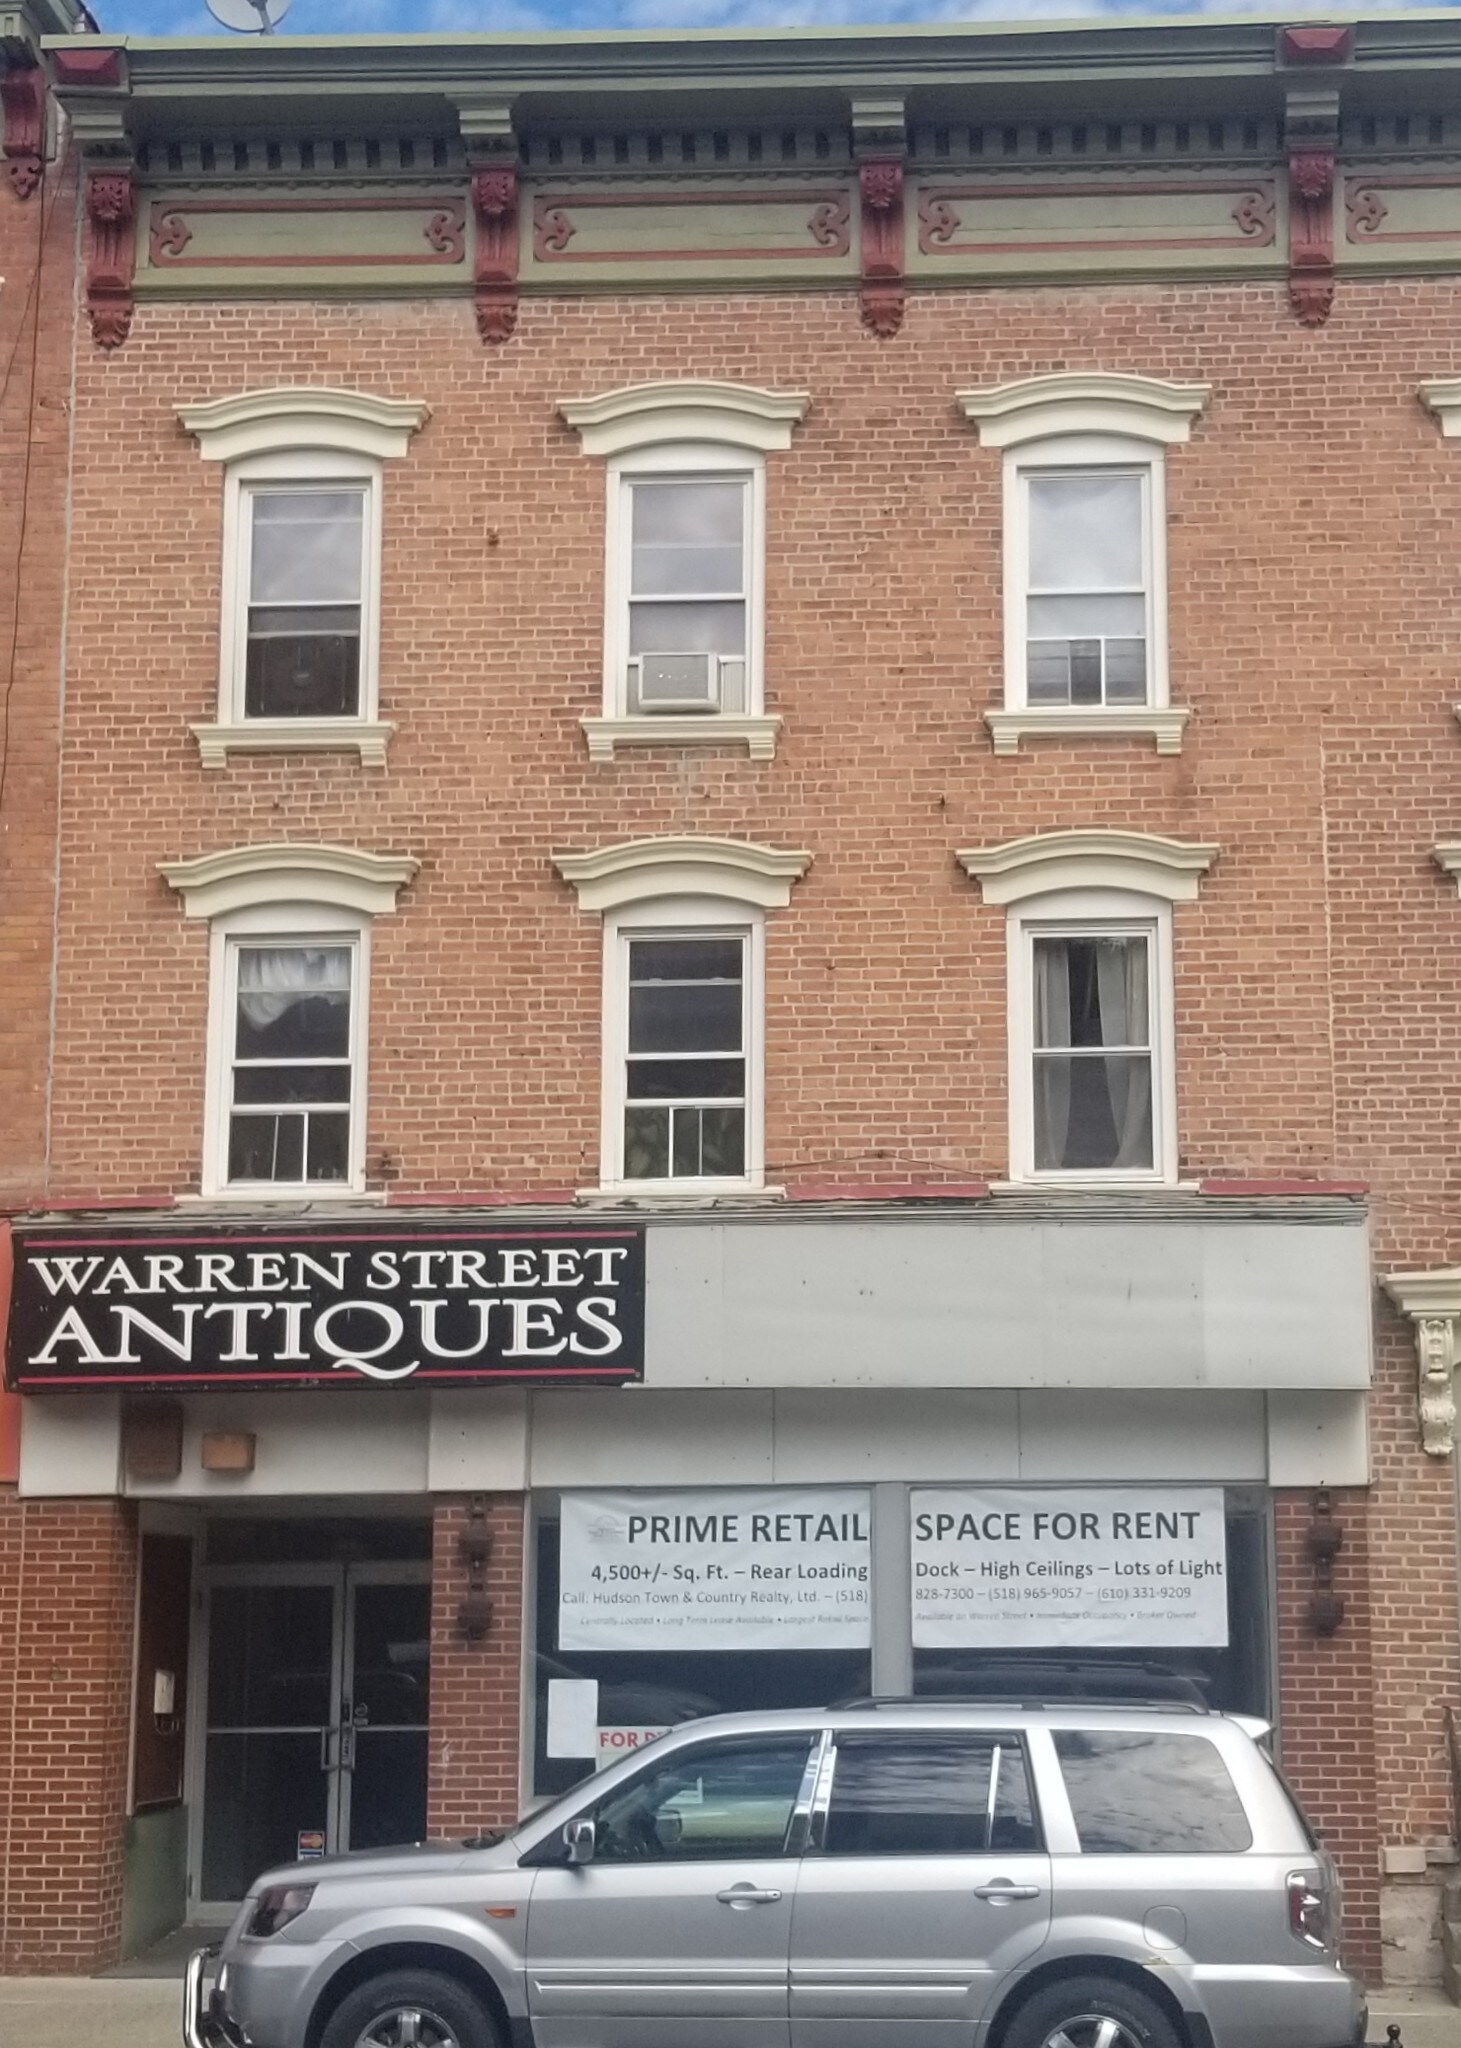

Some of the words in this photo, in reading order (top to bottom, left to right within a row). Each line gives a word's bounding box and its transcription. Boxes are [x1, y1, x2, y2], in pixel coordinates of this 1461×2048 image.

[28, 1252, 351, 1295] WARREN
[366, 1248, 628, 1290] STREET
[28, 1297, 624, 1380] ANTIQUES
[628, 1515, 739, 1543] PRIME
[751, 1513, 868, 1542] RETAIL
[915, 1513, 1021, 1541] SPACE
[1033, 1512, 1101, 1540] FOR
[1112, 1511, 1201, 1539] RENT
[591, 1563, 668, 1583] 4,500+/-
[673, 1565, 700, 1583] Sq.
[706, 1564, 728, 1580] Ft.
[750, 1563, 792, 1580] Rear
[797, 1562, 868, 1582] Loading
[915, 1561, 959, 1577] Dock
[980, 1560, 1020, 1580] High
[1026, 1560, 1094, 1580] Ceilings
[1114, 1560, 1151, 1576] Lots
[1155, 1559, 1175, 1576] of
[1179, 1559, 1223, 1579] Light
[593, 1592, 640, 1604] Hudson
[644, 1592, 680, 1604] Town
[682, 1591, 693, 1604] &
[696, 1590, 747, 1606] Country
[750, 1590, 793, 1605] Realty,
[835, 1589, 868, 1605] (518)
[915, 1587, 974, 1600] 828-7300
[988, 1587, 1021, 1602] (518)
[1023, 1586, 1083, 1600] 965-9057
[1097, 1587, 1129, 1602] (610)
[1132, 1586, 1192, 1599] 331-9209
[600, 1732, 638, 1748] FOR
